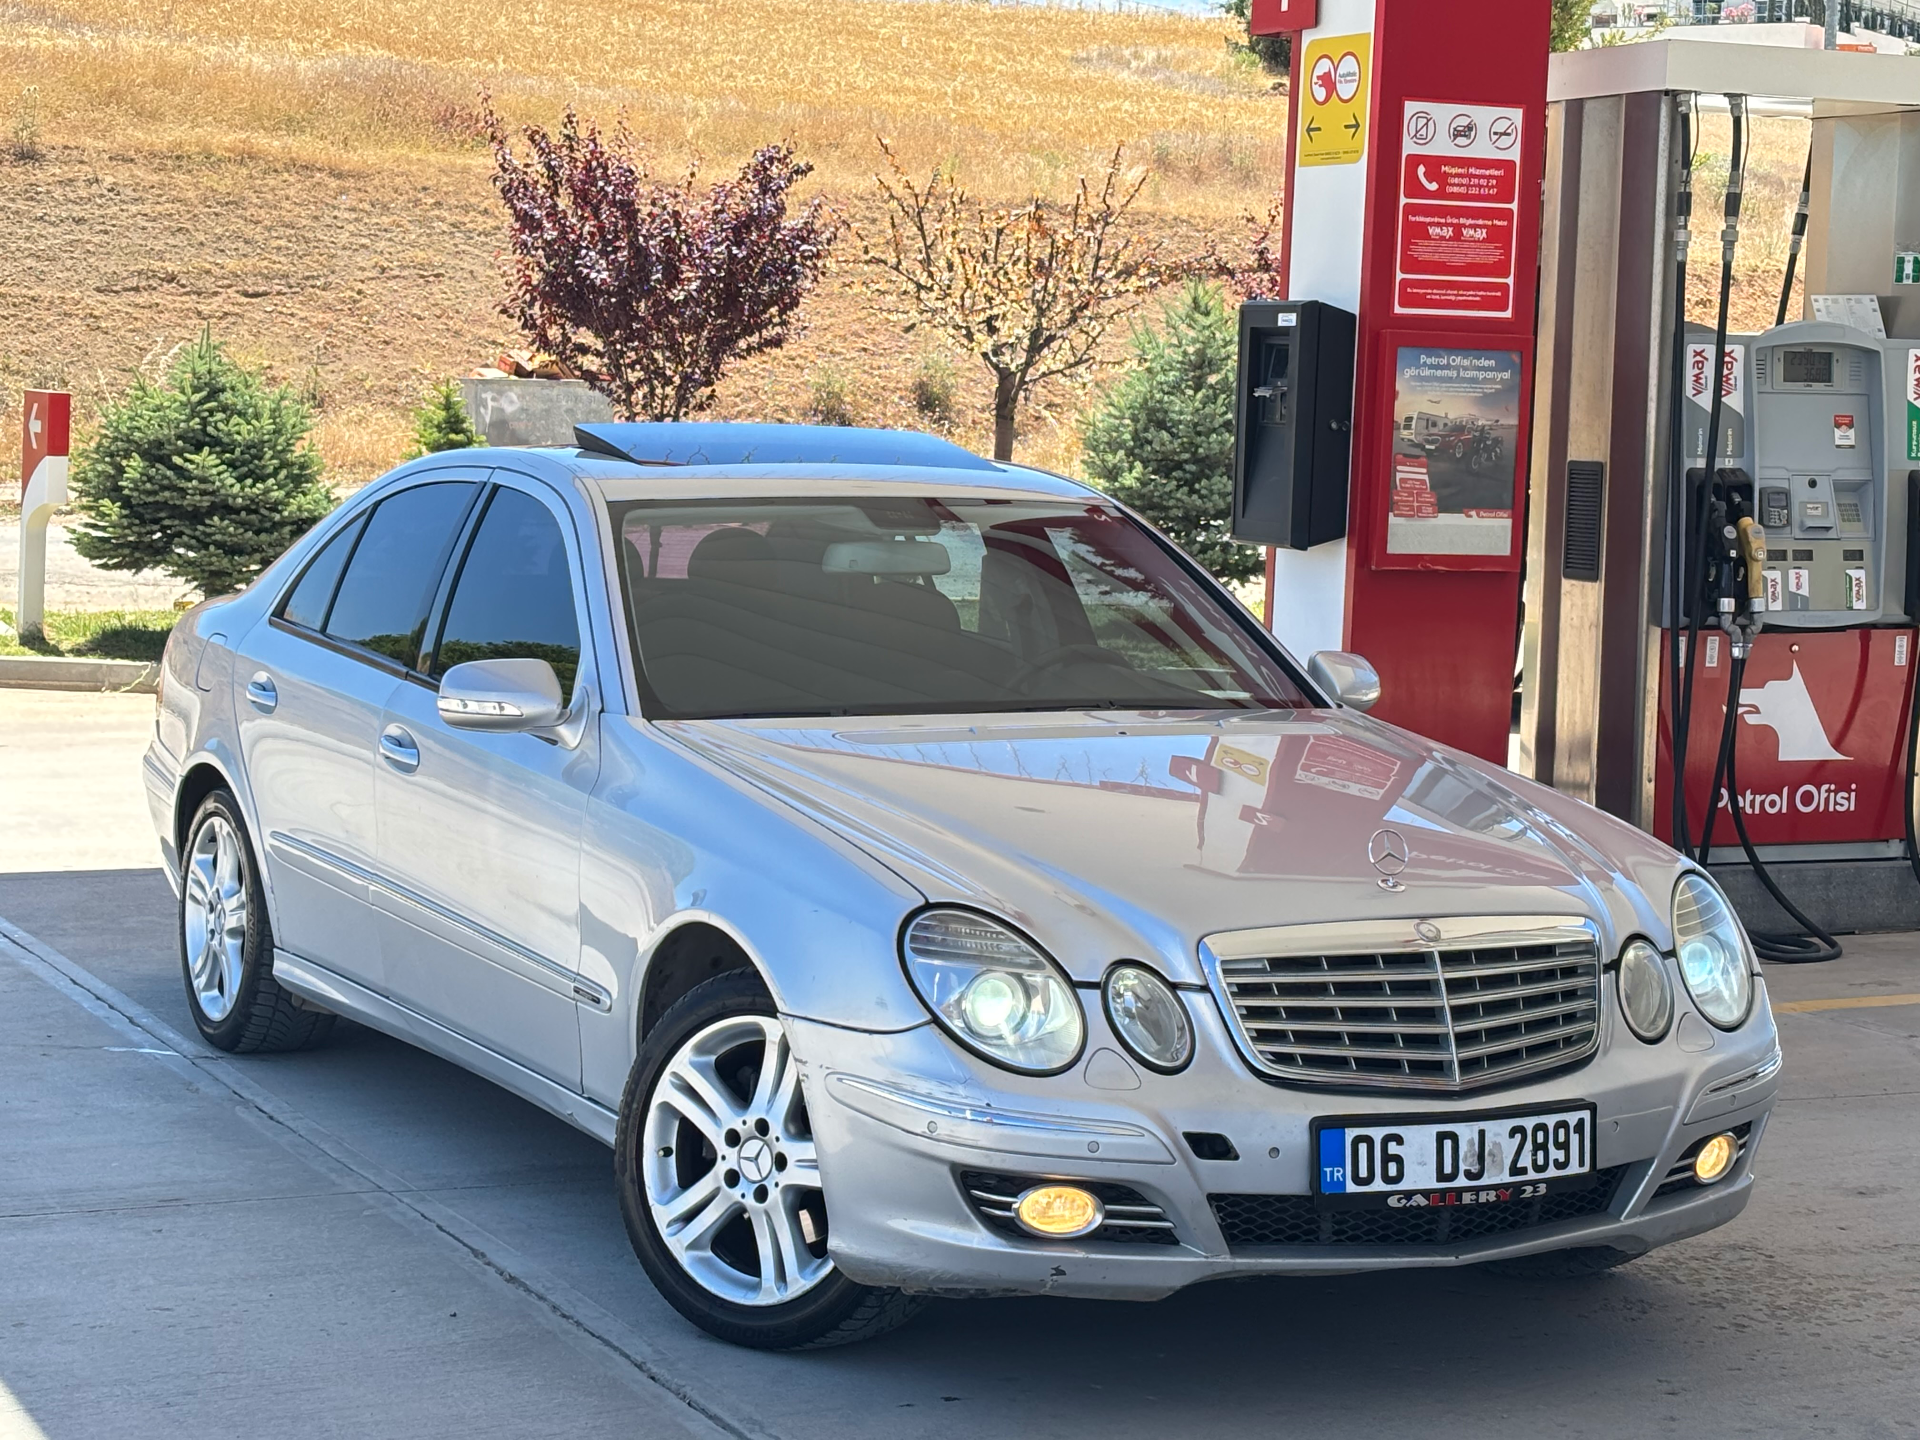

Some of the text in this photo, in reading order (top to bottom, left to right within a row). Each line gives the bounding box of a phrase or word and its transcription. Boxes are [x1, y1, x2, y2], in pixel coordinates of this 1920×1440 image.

[1441, 165, 1504, 176] Müşteri Hizmetleri
[1420, 355, 1496, 367] Petrol Ofisi'nden
[1403, 367, 1458, 379] görülmemiş
[1795, 783, 1857, 812] Ofisi
[1350, 1117, 1586, 1187] 06 DJ 2891
[1323, 1166, 1344, 1182] TR
[1387, 1183, 1547, 1207] GALLERY 23
